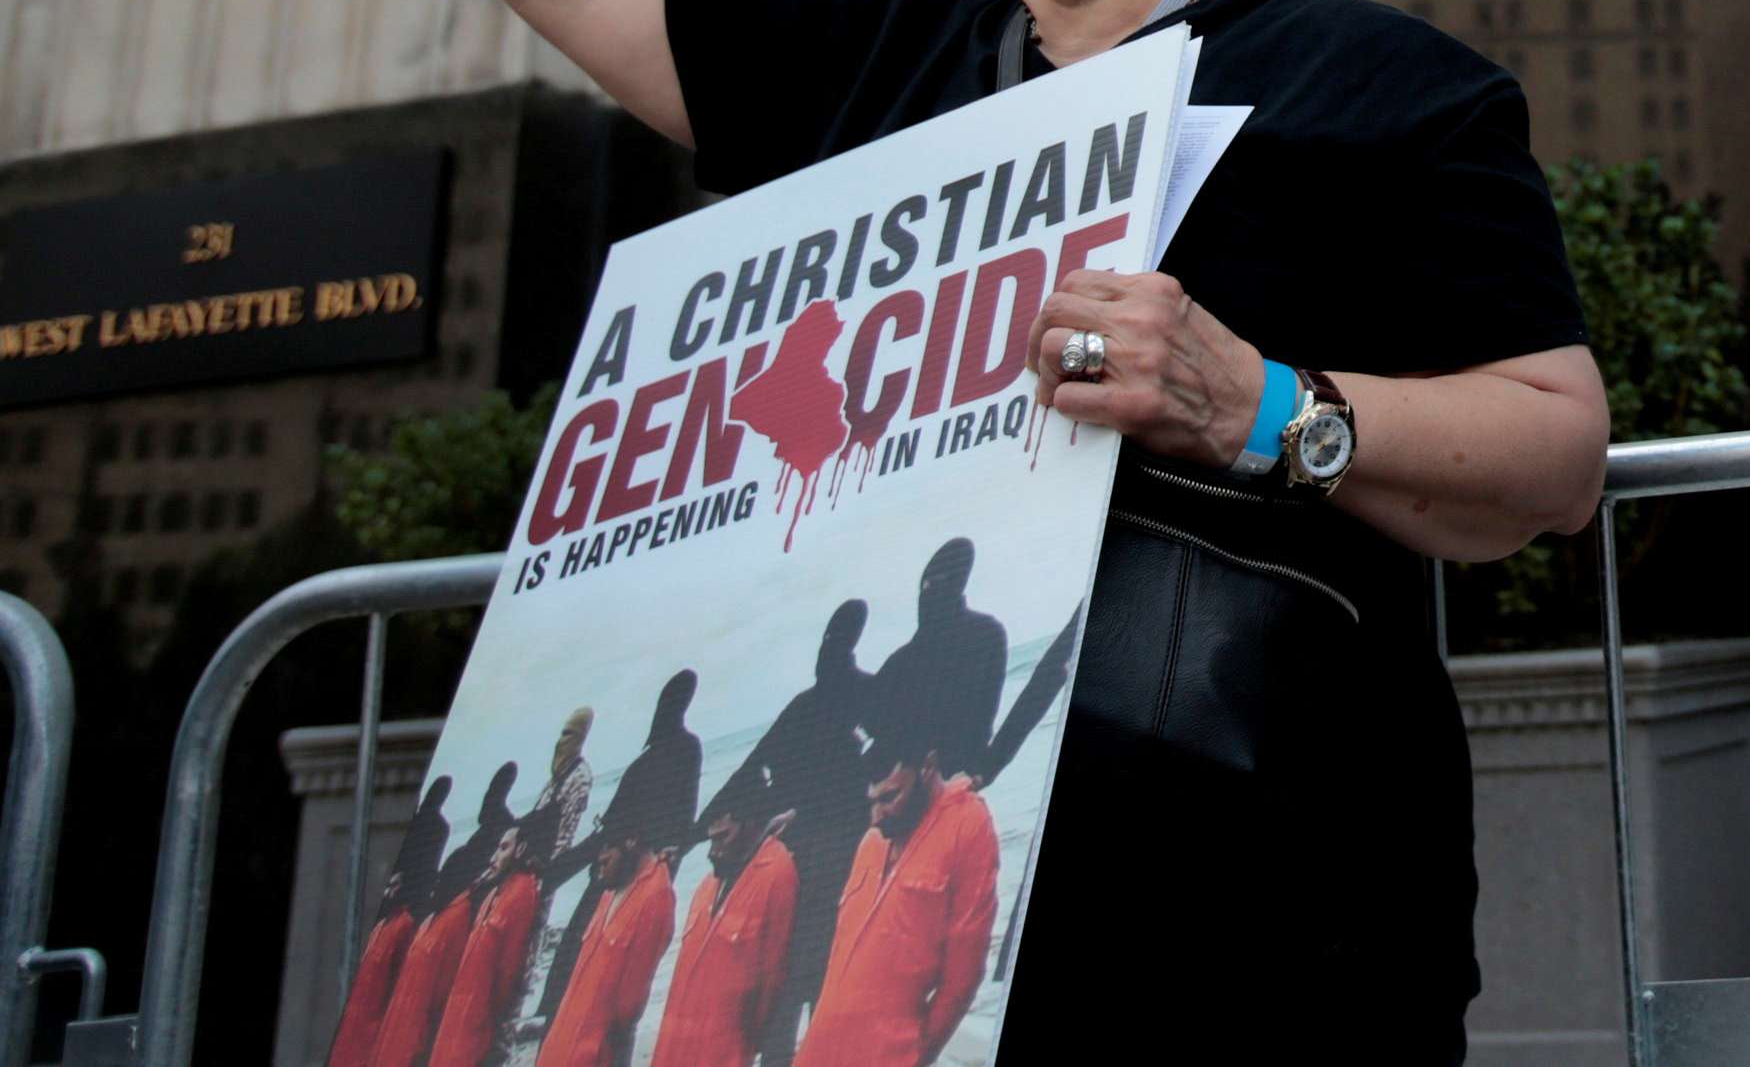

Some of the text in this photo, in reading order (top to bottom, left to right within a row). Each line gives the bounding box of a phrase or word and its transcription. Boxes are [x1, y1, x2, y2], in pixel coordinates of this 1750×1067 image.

[101, 286, 303, 348] LAFAYETTE
[314, 273, 423, 321] BLVD.
[578, 304, 636, 398] A
[669, 111, 1147, 363] CHRISTIAN
[513, 393, 1028, 594] IS HAPPENING IN IRAQ
[528, 212, 1130, 545] GENCID
